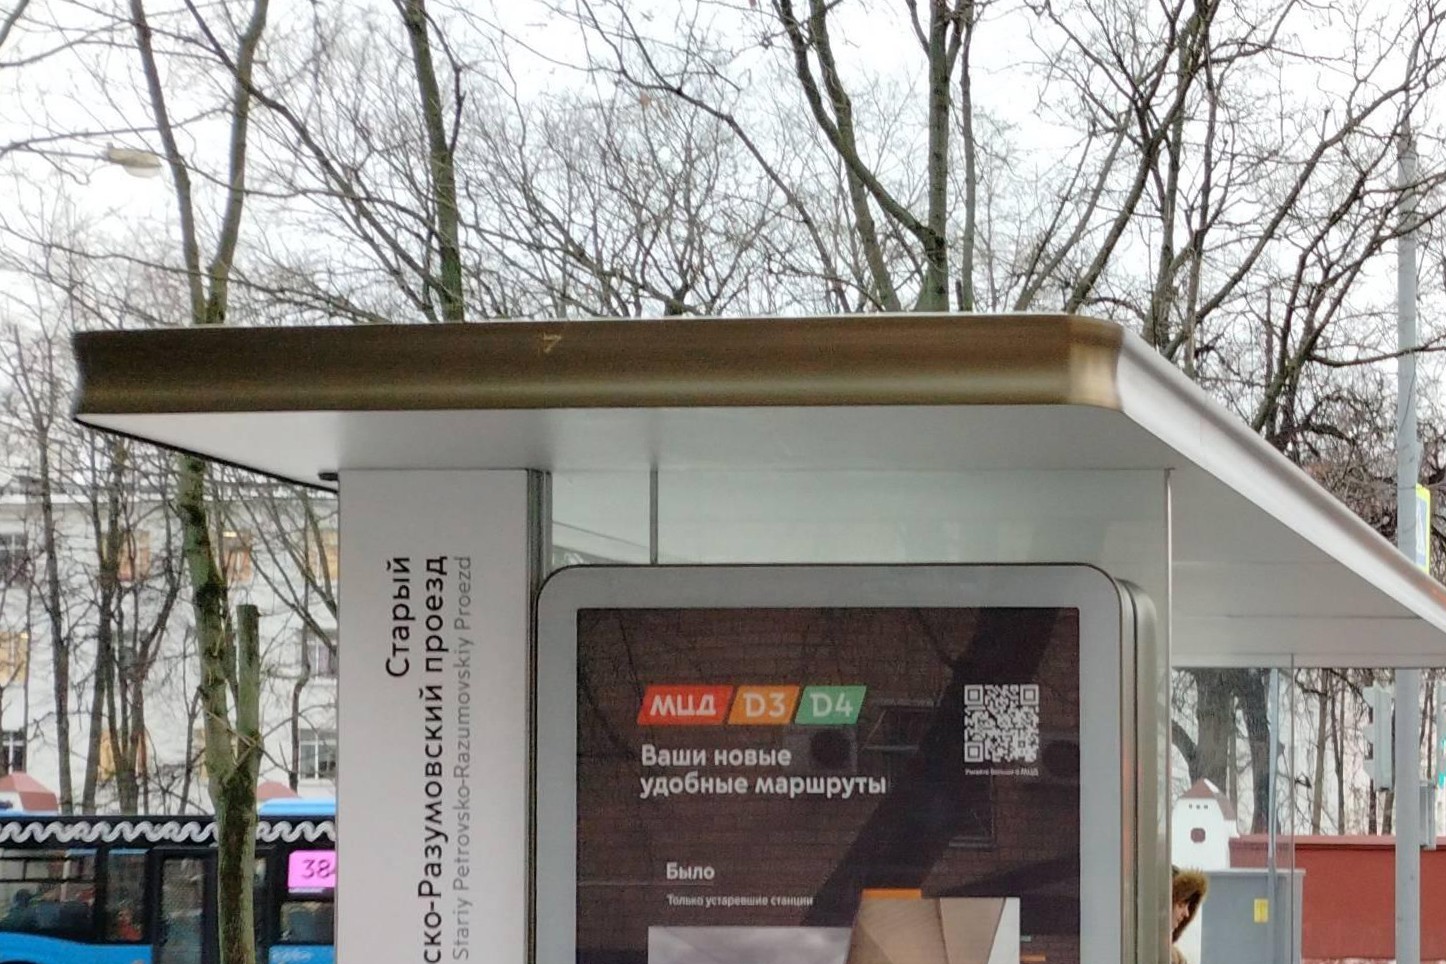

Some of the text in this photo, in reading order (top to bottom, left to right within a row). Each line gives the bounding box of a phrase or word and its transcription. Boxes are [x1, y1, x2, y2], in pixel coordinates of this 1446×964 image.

[385, 557, 416, 677] Старый
[425, 556, 449, 673] проезд
[649, 692, 854, 717] МЦД D3 D4
[453, 556, 474, 960] Stariy Petrovsko-Razumovskiy Proezd
[641, 744, 792, 766] Ваши новые
[640, 771, 887, 799] удобные маршруты
[301, 858, 335, 879] 38
[666, 862, 716, 880] Было
[666, 893, 814, 908] Только устаревшие станции
